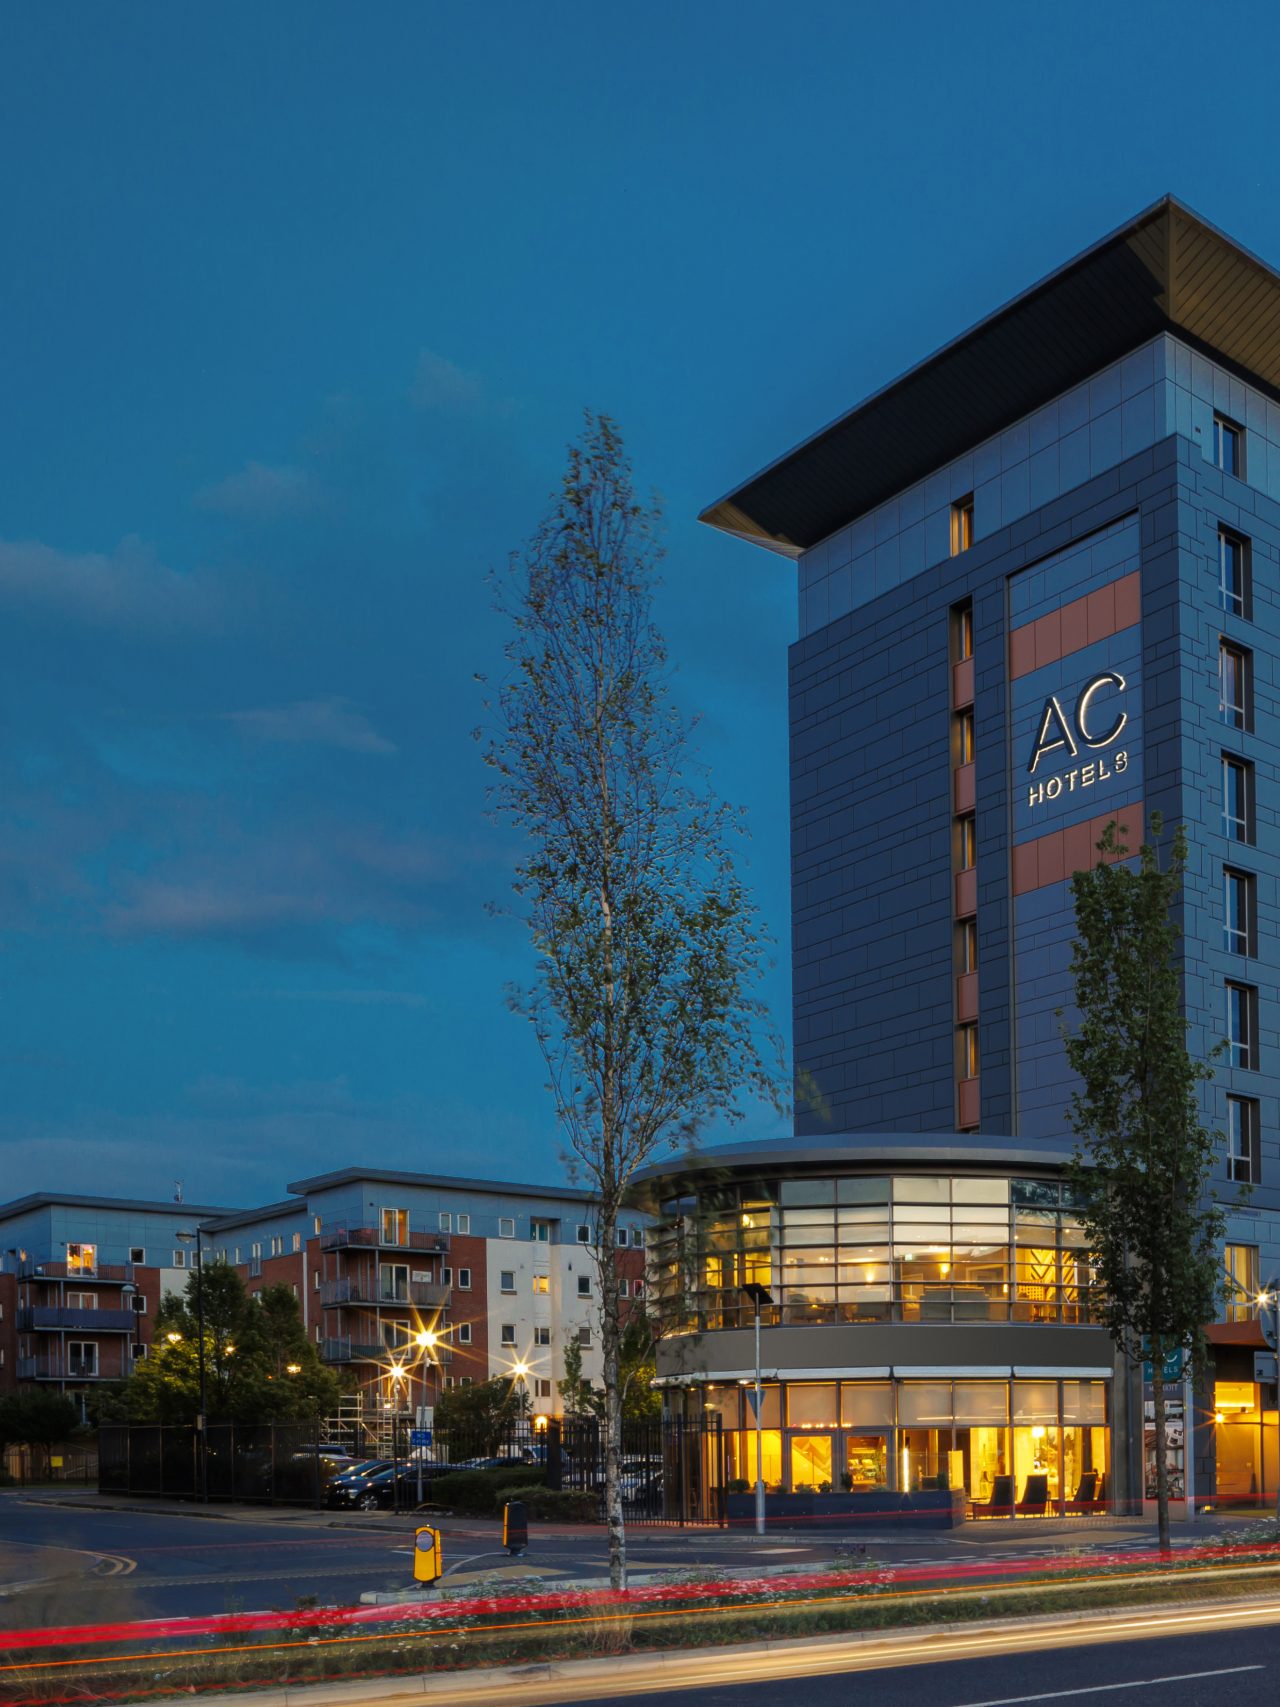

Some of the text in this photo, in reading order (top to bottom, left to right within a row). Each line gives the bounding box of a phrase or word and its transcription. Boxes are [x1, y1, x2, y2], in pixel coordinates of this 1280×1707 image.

[1027, 671, 1128, 773] AC
[1028, 751, 1129, 807] HOTELS
[1147, 1366, 1178, 1374] HELS
